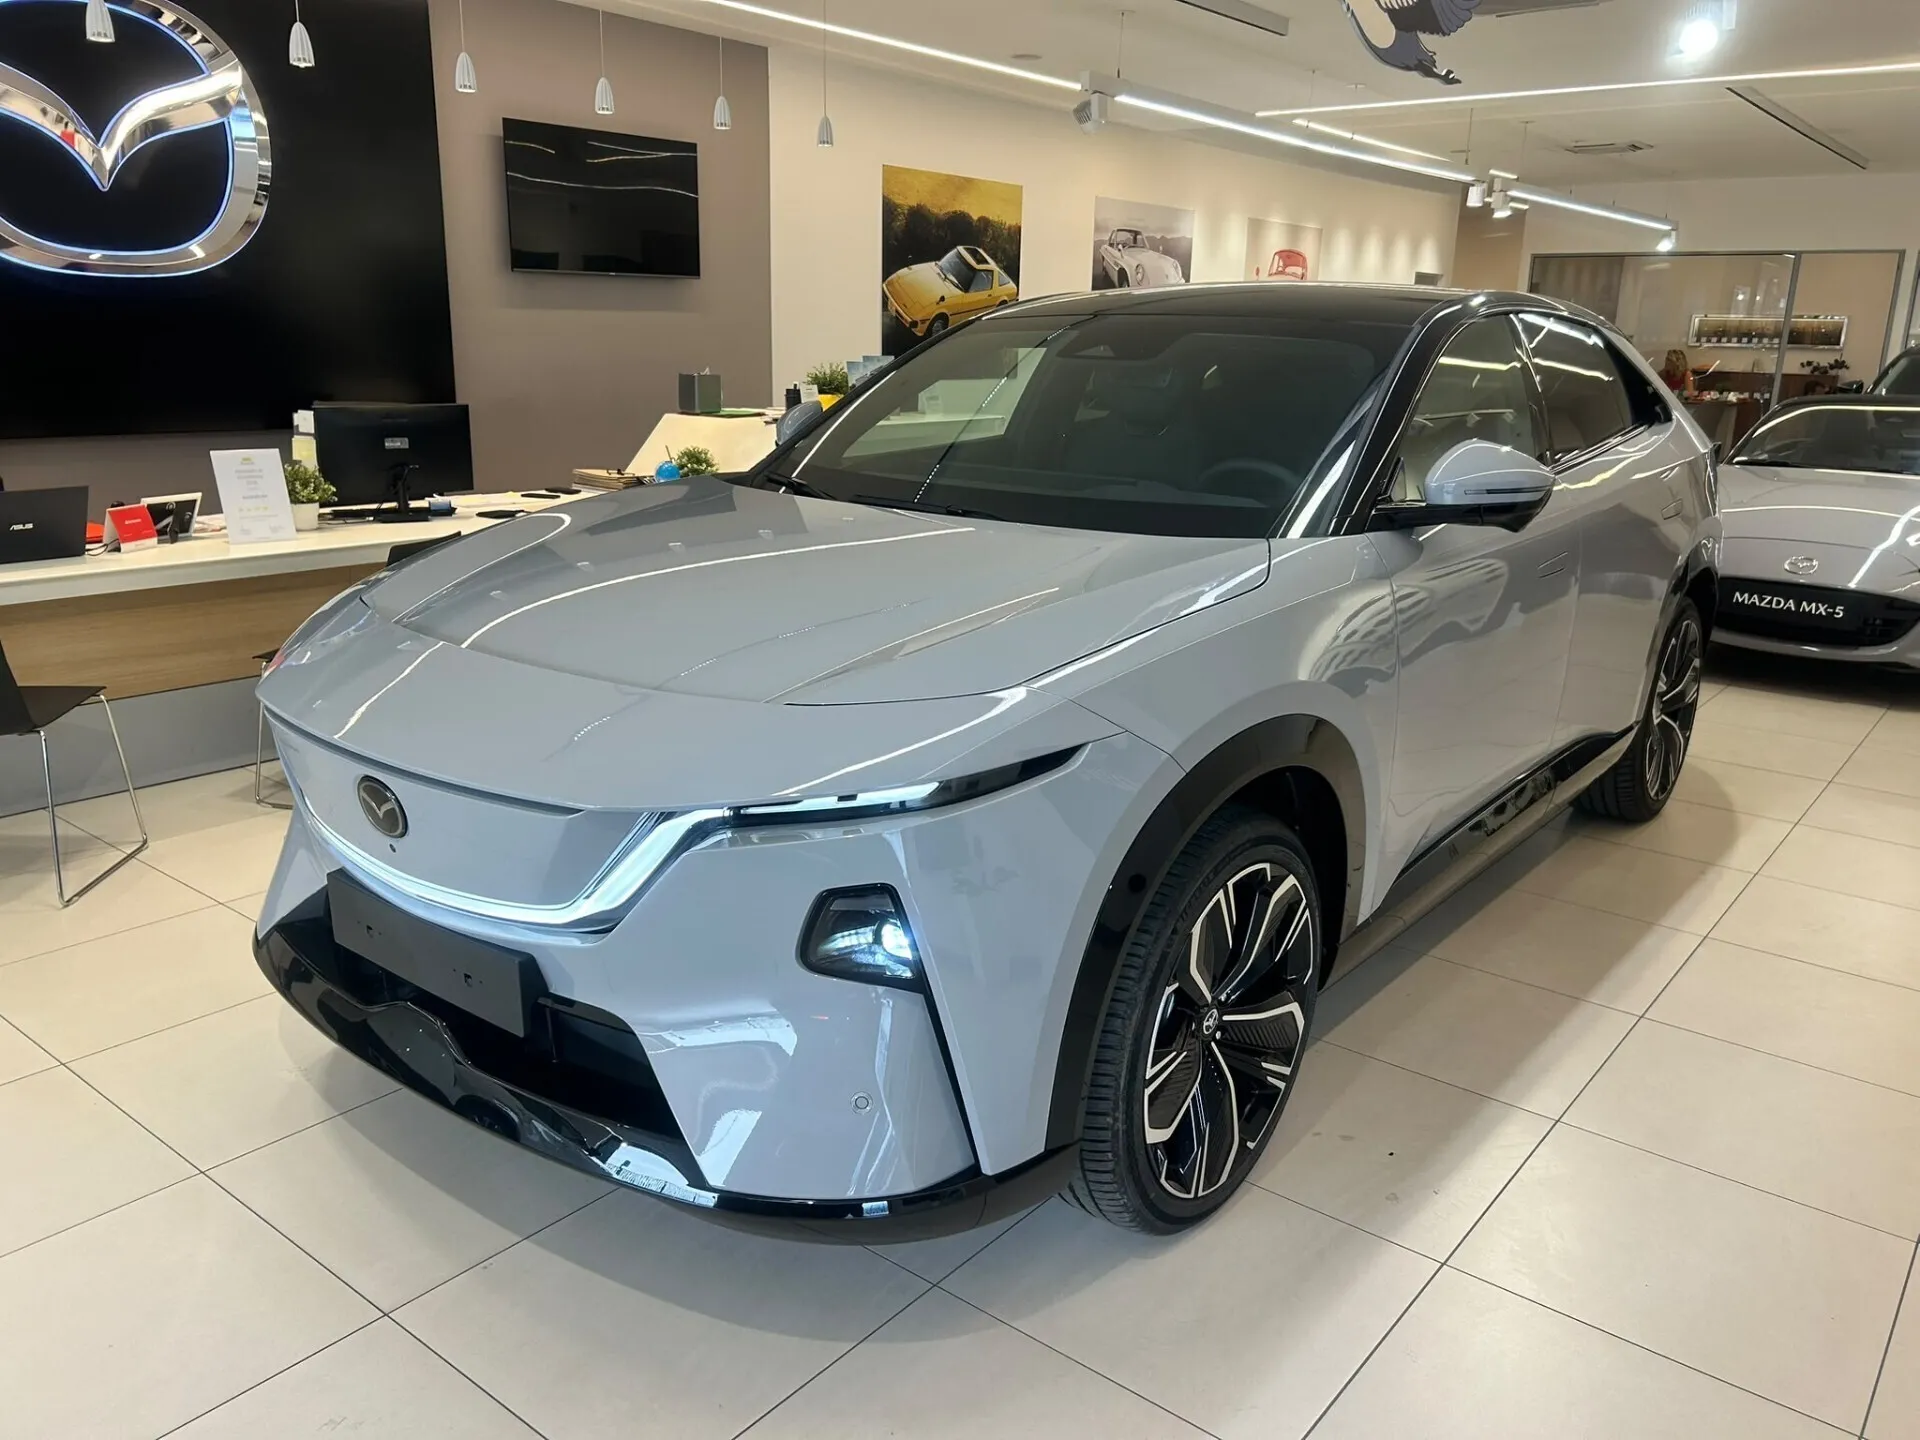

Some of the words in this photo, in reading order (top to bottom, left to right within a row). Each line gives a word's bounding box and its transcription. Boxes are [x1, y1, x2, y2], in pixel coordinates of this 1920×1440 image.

[9, 522, 34, 531] ASUS
[1733, 591, 1795, 611] MAZDA
[1800, 600, 1845, 618] MX-5
